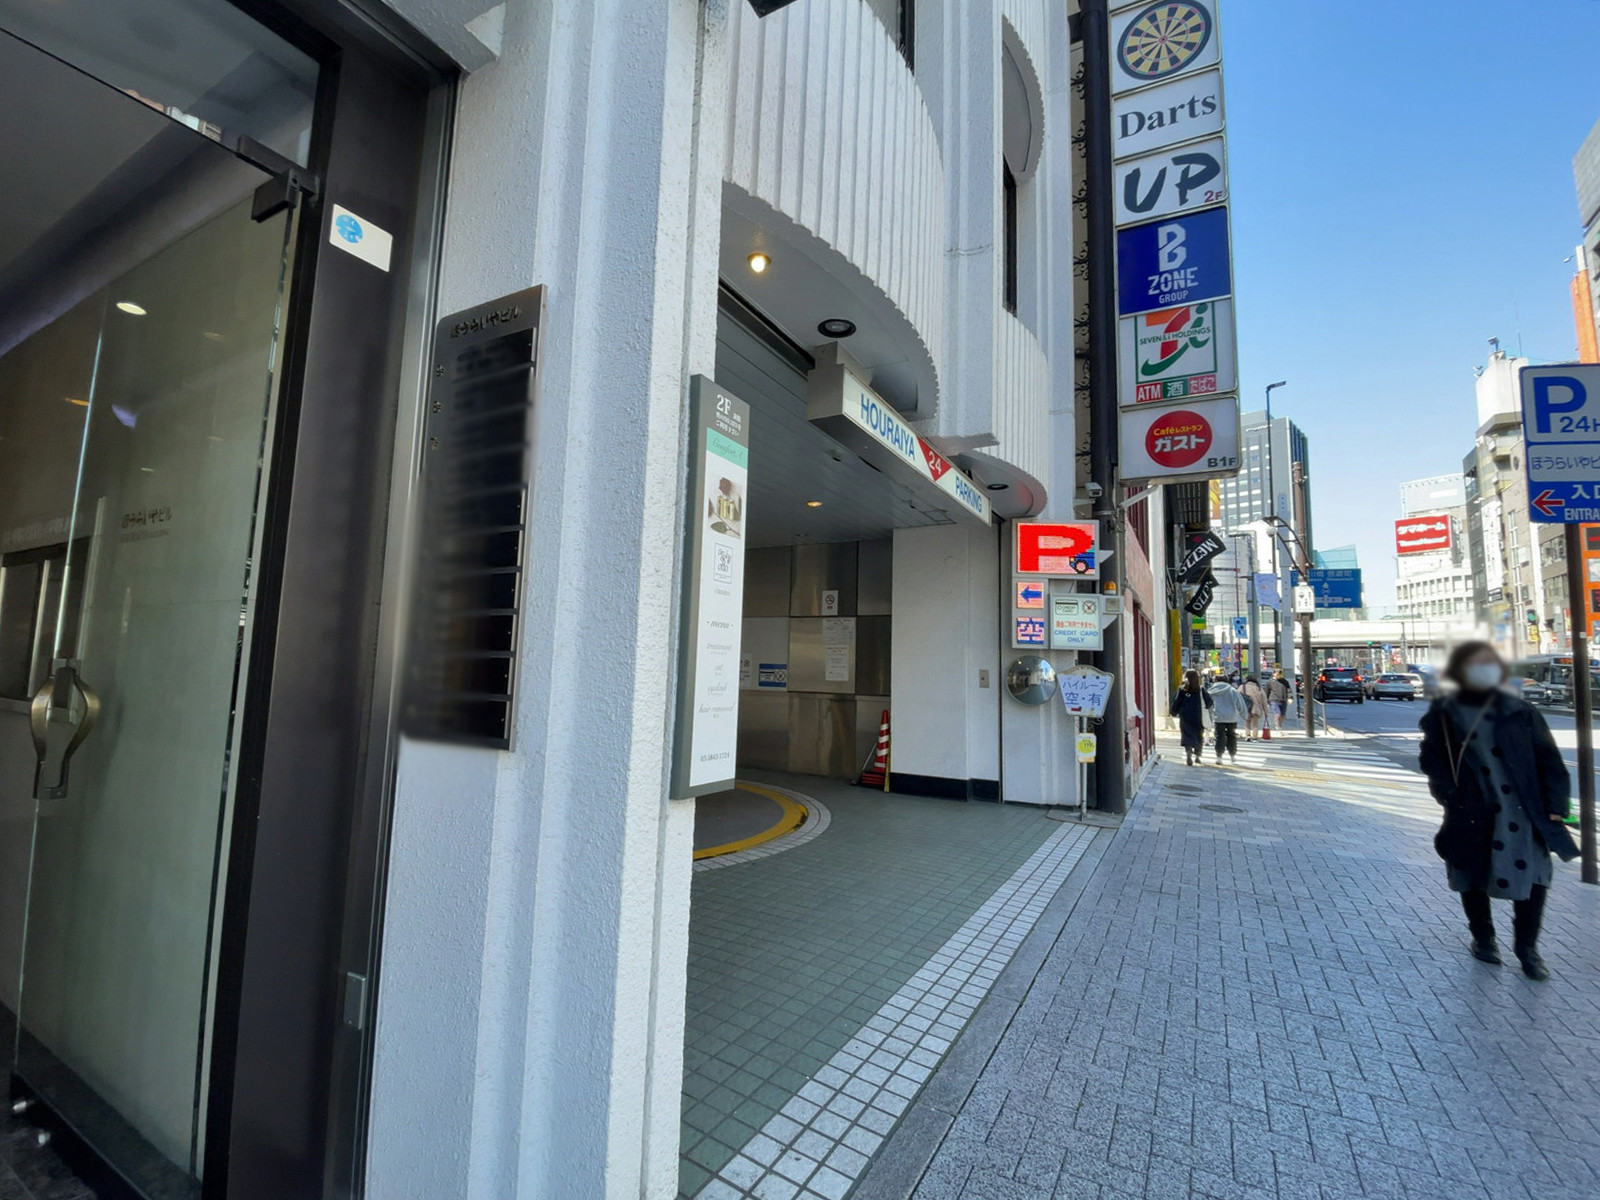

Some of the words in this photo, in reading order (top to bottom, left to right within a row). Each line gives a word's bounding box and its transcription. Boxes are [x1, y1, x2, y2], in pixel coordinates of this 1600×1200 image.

[1118, 94, 1217, 139] Darts
[1123, 152, 1220, 213] UP
[1204, 190, 1224, 204] 2F
[1158, 222, 1187, 271] B
[1148, 267, 1199, 295] ZONE
[1158, 289, 1189, 304] GROUP
[1172, 326, 1211, 339] HOLDINGS
[1137, 384, 1161, 401] ATM
[1166, 381, 1184, 397] 酒
[1189, 376, 1215, 393] たばこ
[716, 394, 731, 415] 2F
[1533, 376, 1587, 434] P
[860, 393, 916, 461] HOURAIYA
[928, 451, 942, 476] 24
[956, 476, 983, 513] PARKING
[1154, 434, 1205, 453] ガスト
[1208, 456, 1236, 468] B1F
[1018, 524, 1092, 572] P
[1178, 538, 1219, 576] MEZZO
[1017, 618, 1045, 644] 空
[1062, 681, 1107, 691] ハイルーフ
